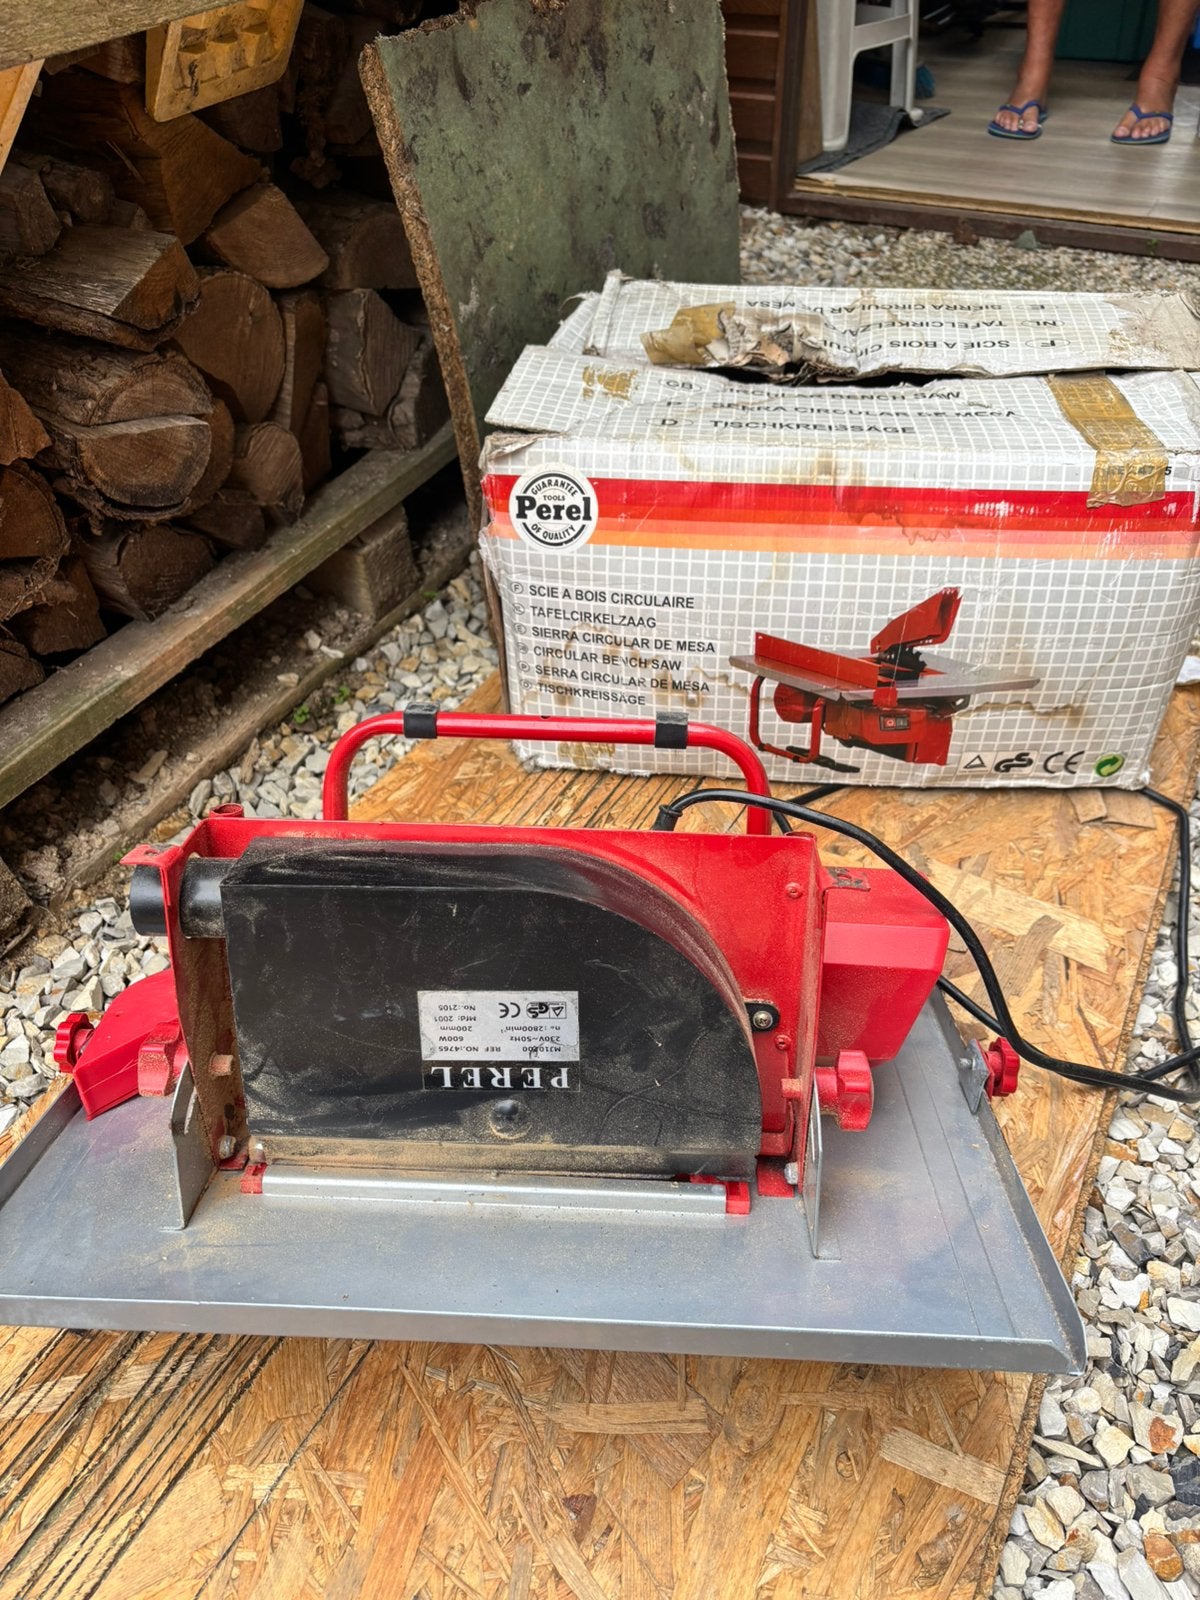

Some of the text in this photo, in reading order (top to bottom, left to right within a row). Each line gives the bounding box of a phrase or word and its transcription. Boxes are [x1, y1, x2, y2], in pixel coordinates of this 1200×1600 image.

[747, 301, 796, 309] MESA
[930, 303, 1002, 312] SIERRA
[889, 340, 938, 349] BOIS
[943, 341, 957, 349] A
[963, 340, 1010, 350] SCIE
[661, 418, 678, 426] D
[531, 478, 579, 497] GUARANTEE
[543, 494, 566, 502] TOOLS
[515, 495, 593, 521] Perel
[531, 523, 577, 541] OF QUALITY
[529, 584, 560, 599] SCIE
[562, 588, 572, 600] A
[575, 589, 607, 603] BOIS
[611, 592, 695, 609] CIRCULAIRE
[530, 605, 657, 629] TAFELCIRKELZAAG
[531, 626, 579, 642] SIERRA
[582, 631, 650, 649] CIRCULAR
[654, 639, 672, 651] DE
[676, 640, 716, 653] MESA
[533, 645, 598, 663] CIRCULAR
[602, 654, 648, 669] BENCH
[651, 658, 682, 671] SAW
[535, 664, 578, 680] SERRA
[581, 670, 647, 688] CIRCULAR
[650, 678, 669, 690] DE
[672, 680, 710, 692] MESA
[1043, 750, 1085, 774] CE
[434, 1014, 454, 1023] 2001
[499, 1002, 521, 1019] CE
[438, 1035, 465, 1043] 600W
[485, 1045, 502, 1053] REF
[430, 1066, 570, 1089] PEREL
